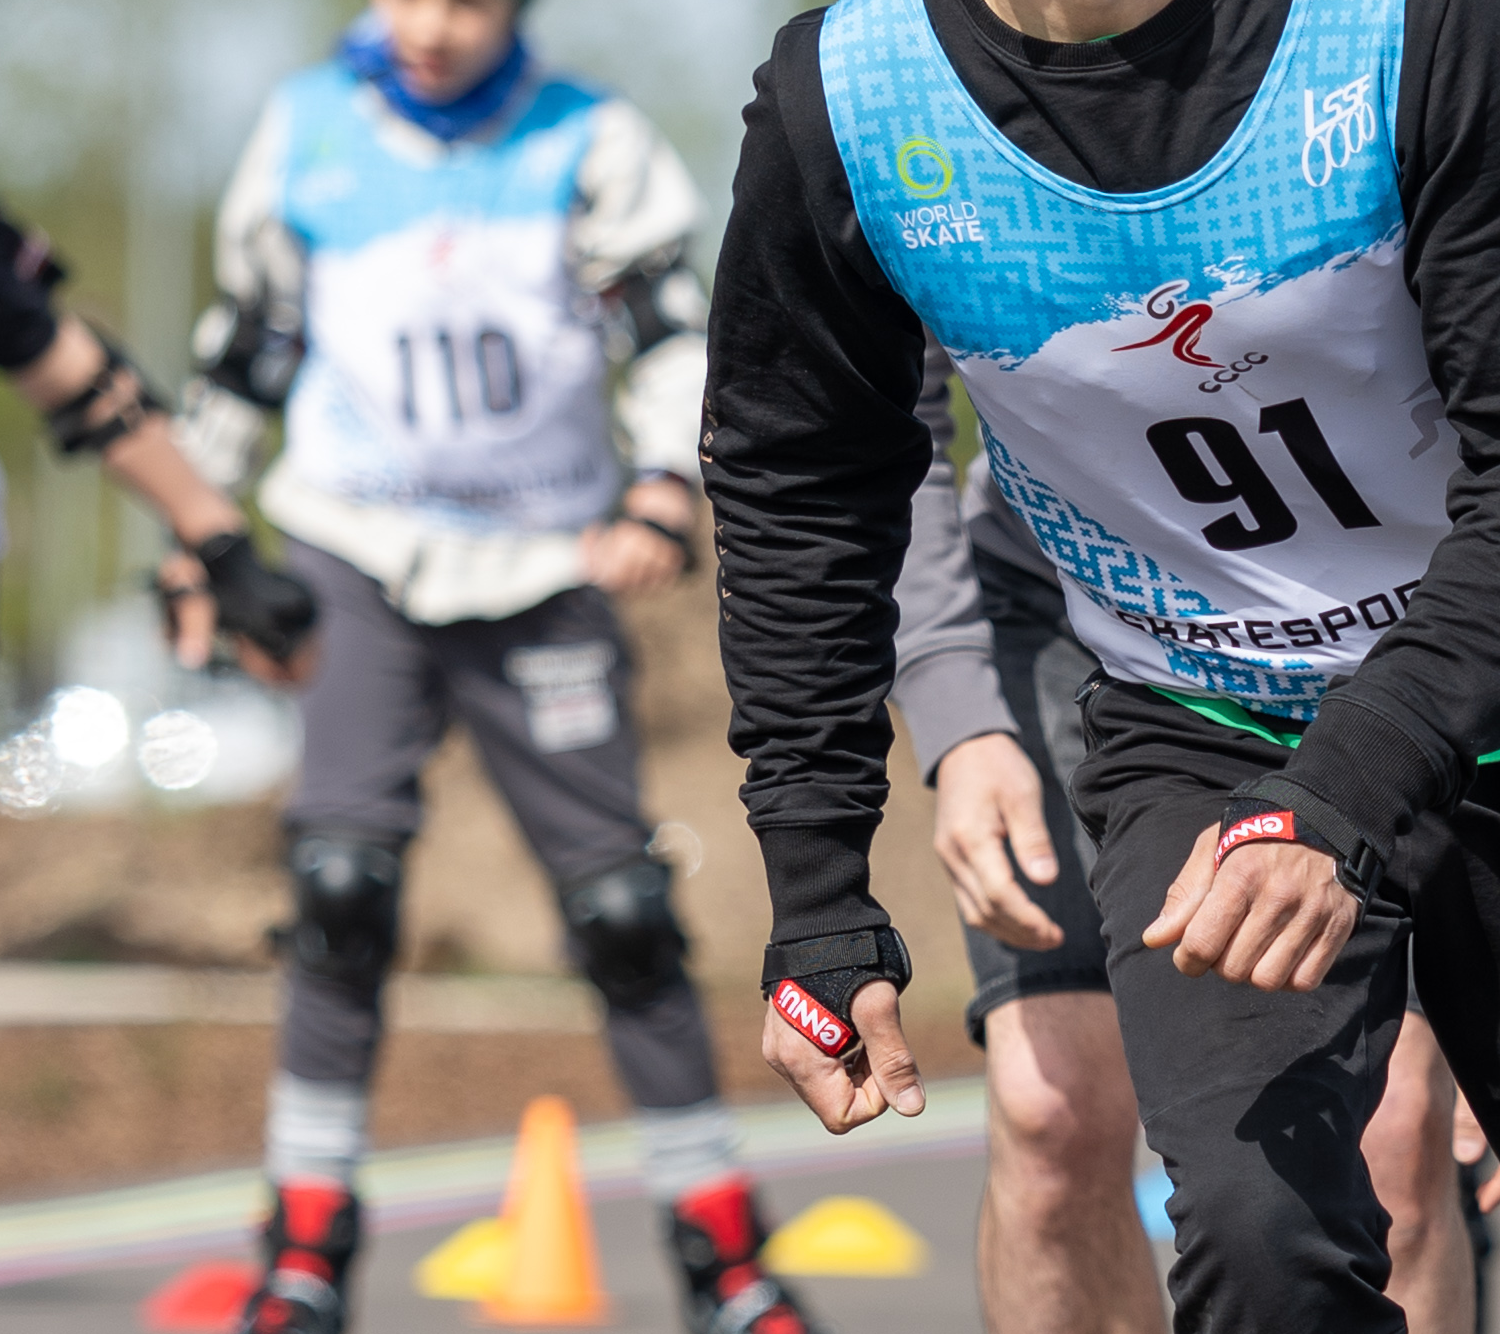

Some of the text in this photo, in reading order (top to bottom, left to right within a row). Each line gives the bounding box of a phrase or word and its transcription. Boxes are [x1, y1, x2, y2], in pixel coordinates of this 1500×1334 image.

[894, 201, 978, 228] WORLD
[902, 220, 985, 249] SKATE
[393, 324, 523, 425] 110
[1144, 396, 1383, 552] 91
